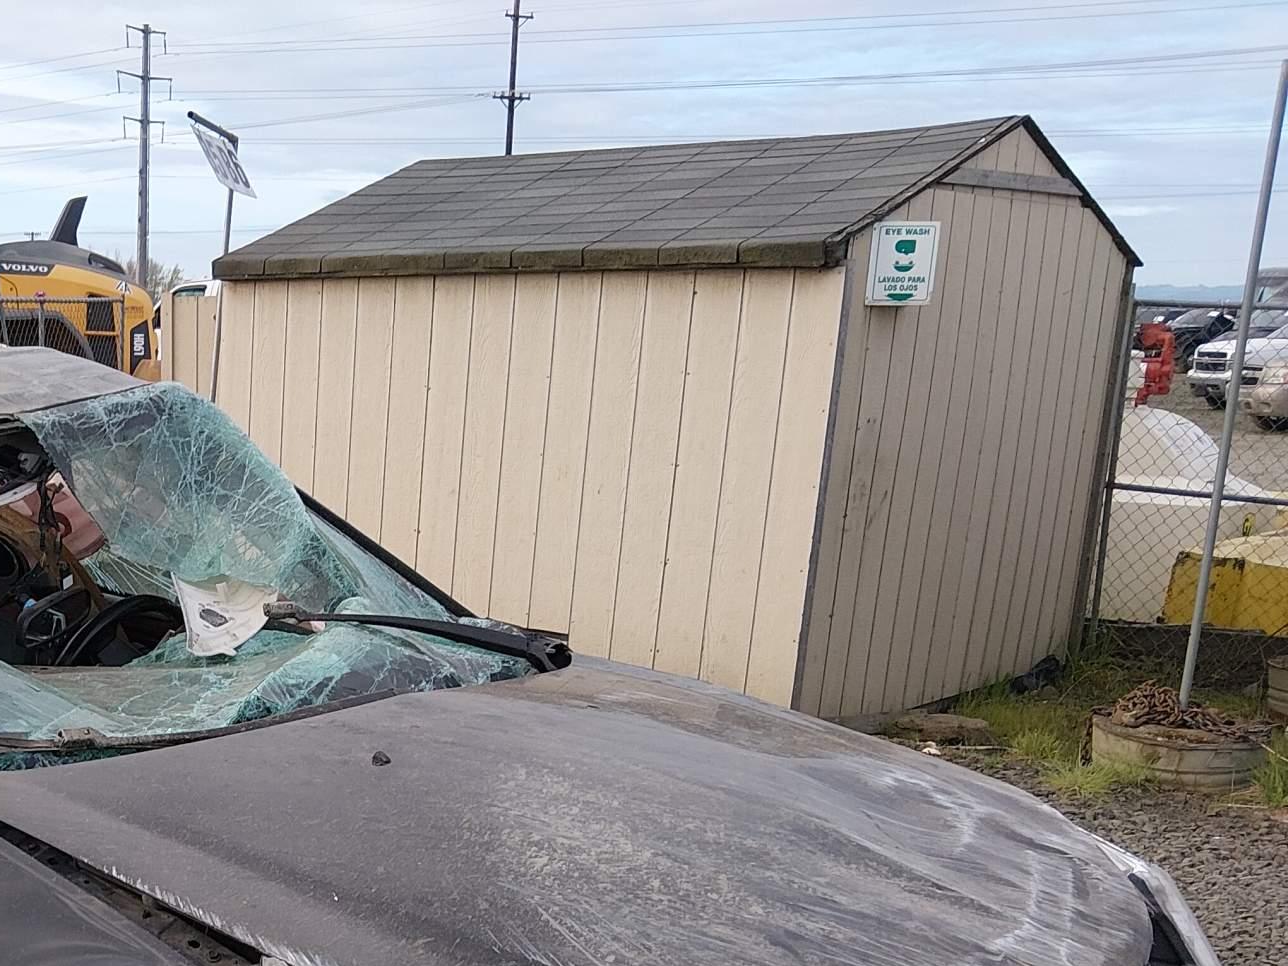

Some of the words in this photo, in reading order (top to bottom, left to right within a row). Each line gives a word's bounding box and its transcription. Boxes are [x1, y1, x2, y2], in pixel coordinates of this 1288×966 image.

[885, 228, 902, 236] EYE
[905, 228, 931, 236] WASH
[1, 262, 49, 273] VOLVO
[877, 276, 906, 284] LAVADO
[883, 284, 898, 292] LOS
[899, 284, 919, 292] OJOS
[133, 333, 145, 356] L90H
